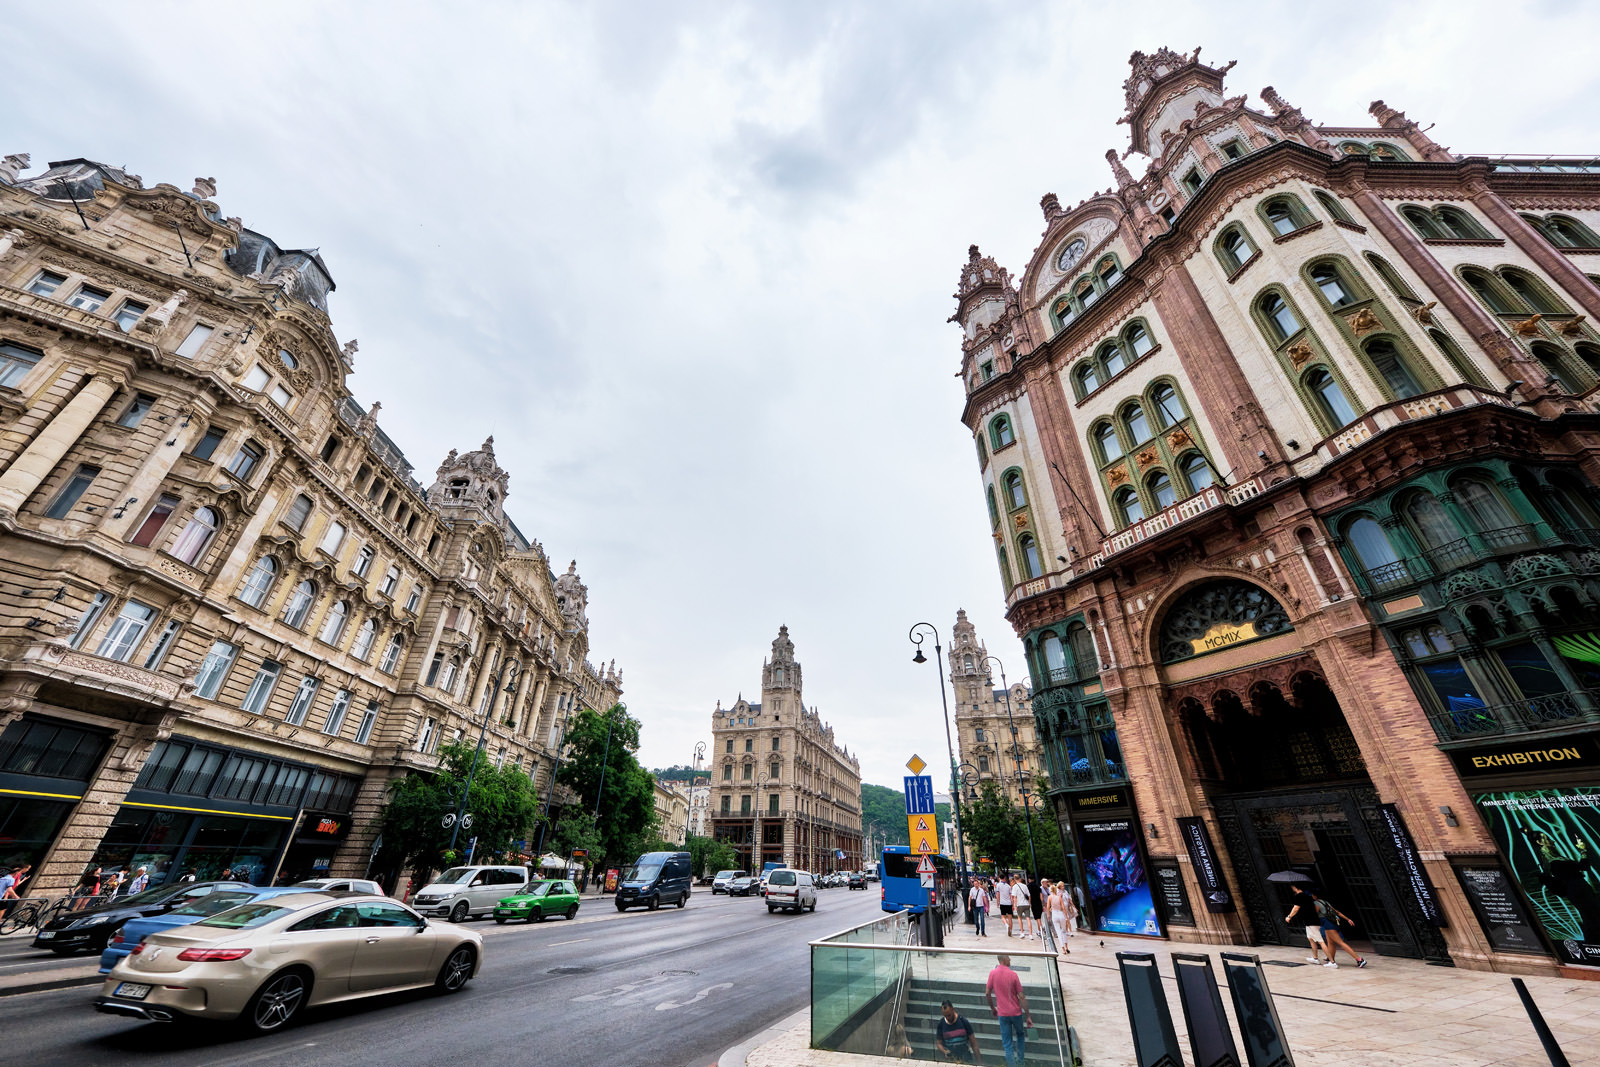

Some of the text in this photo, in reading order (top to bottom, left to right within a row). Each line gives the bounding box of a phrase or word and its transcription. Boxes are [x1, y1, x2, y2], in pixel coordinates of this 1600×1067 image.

[1204, 630, 1242, 649] MCMIX
[1471, 747, 1581, 768] EXHIBITION
[1078, 794, 1118, 806] IMMERSIVE
[1393, 833, 1403, 849] ART
[1405, 849, 1431, 899] INTERACTIVE
[1411, 876, 1431, 920] IMMERSIVE
